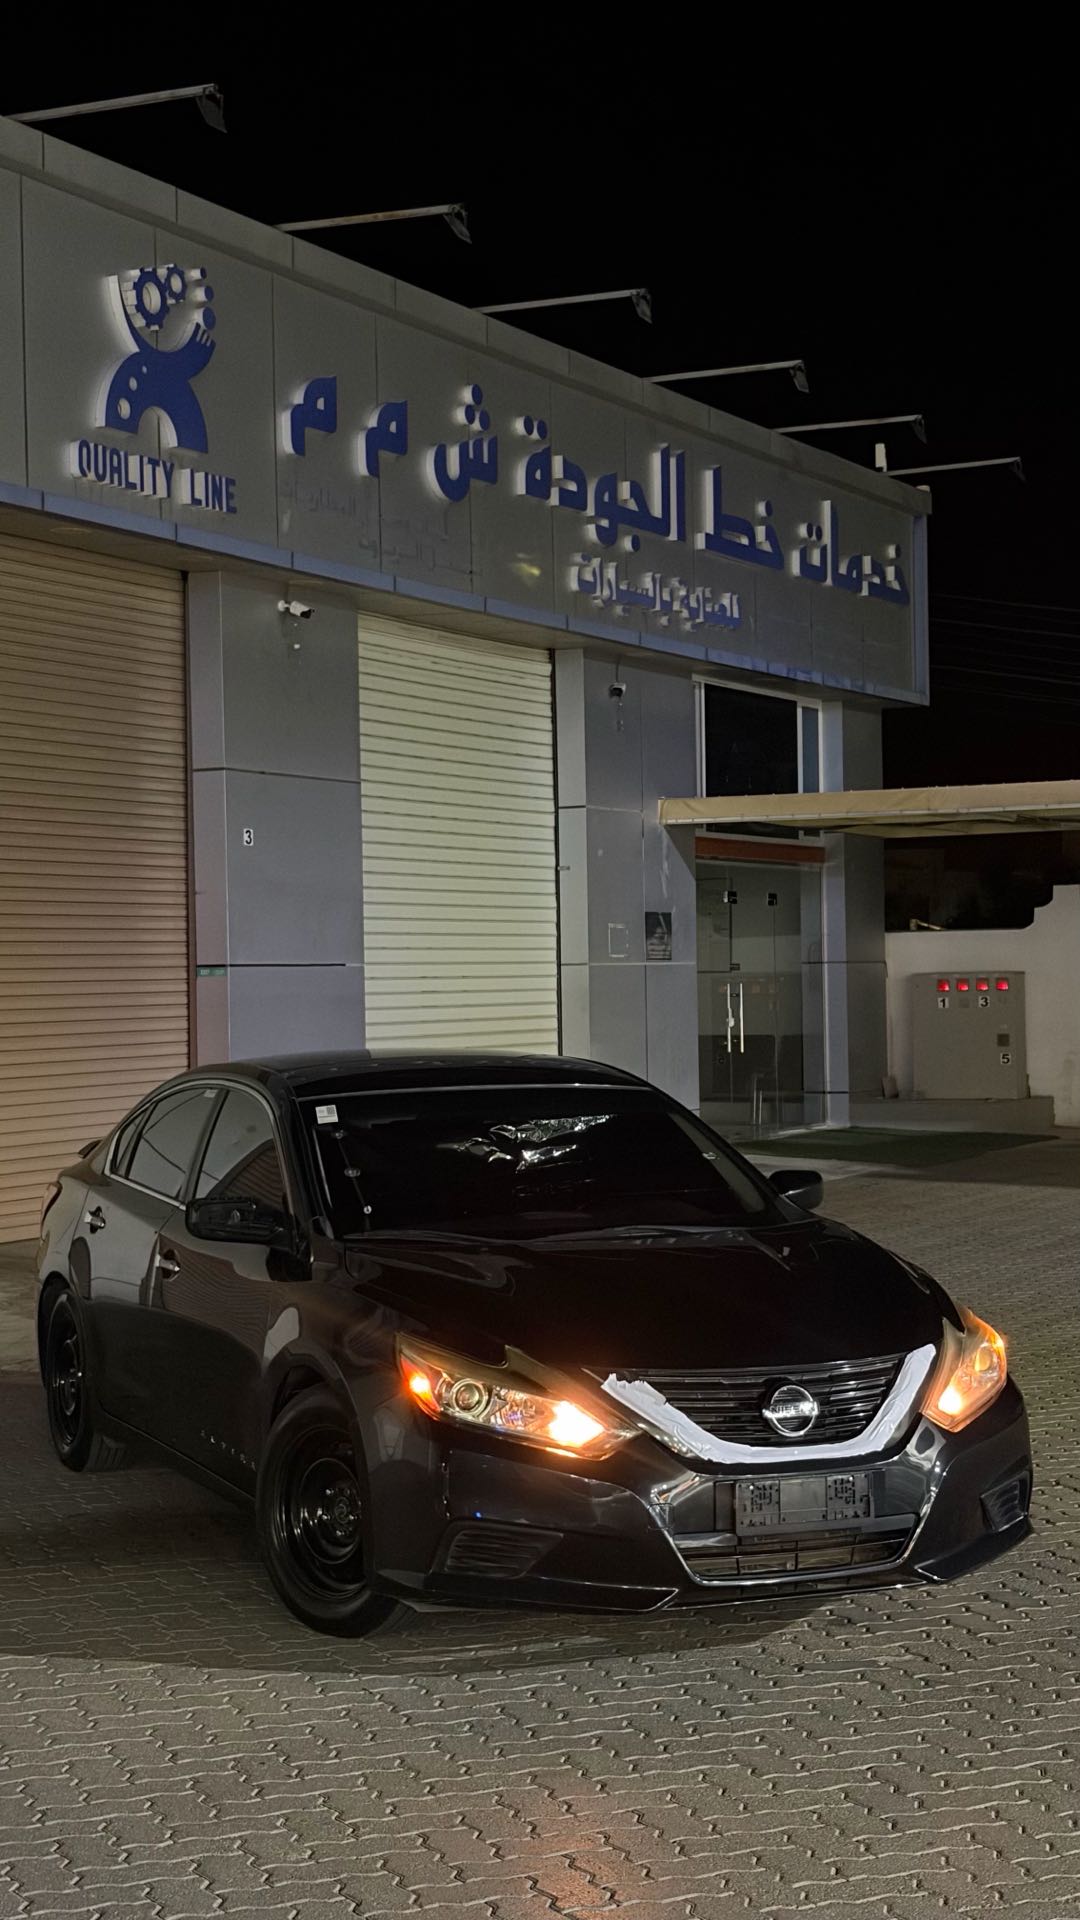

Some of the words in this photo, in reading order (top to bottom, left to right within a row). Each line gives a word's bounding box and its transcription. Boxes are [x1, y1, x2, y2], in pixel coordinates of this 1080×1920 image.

[284, 376, 337, 457] م
[359, 400, 408, 478] م
[430, 384, 498, 502] ش
[72, 440, 174, 498] QUALITY
[185, 468, 237, 514] LINE
[518, 415, 686, 552] الجودة
[698, 465, 785, 570] خط
[795, 500, 910, 606] خدمات
[245, 829, 253, 845] 3
[939, 998, 946, 1008] 1
[980, 997, 989, 1007] 3
[1001, 1054, 1010, 1064] 5
